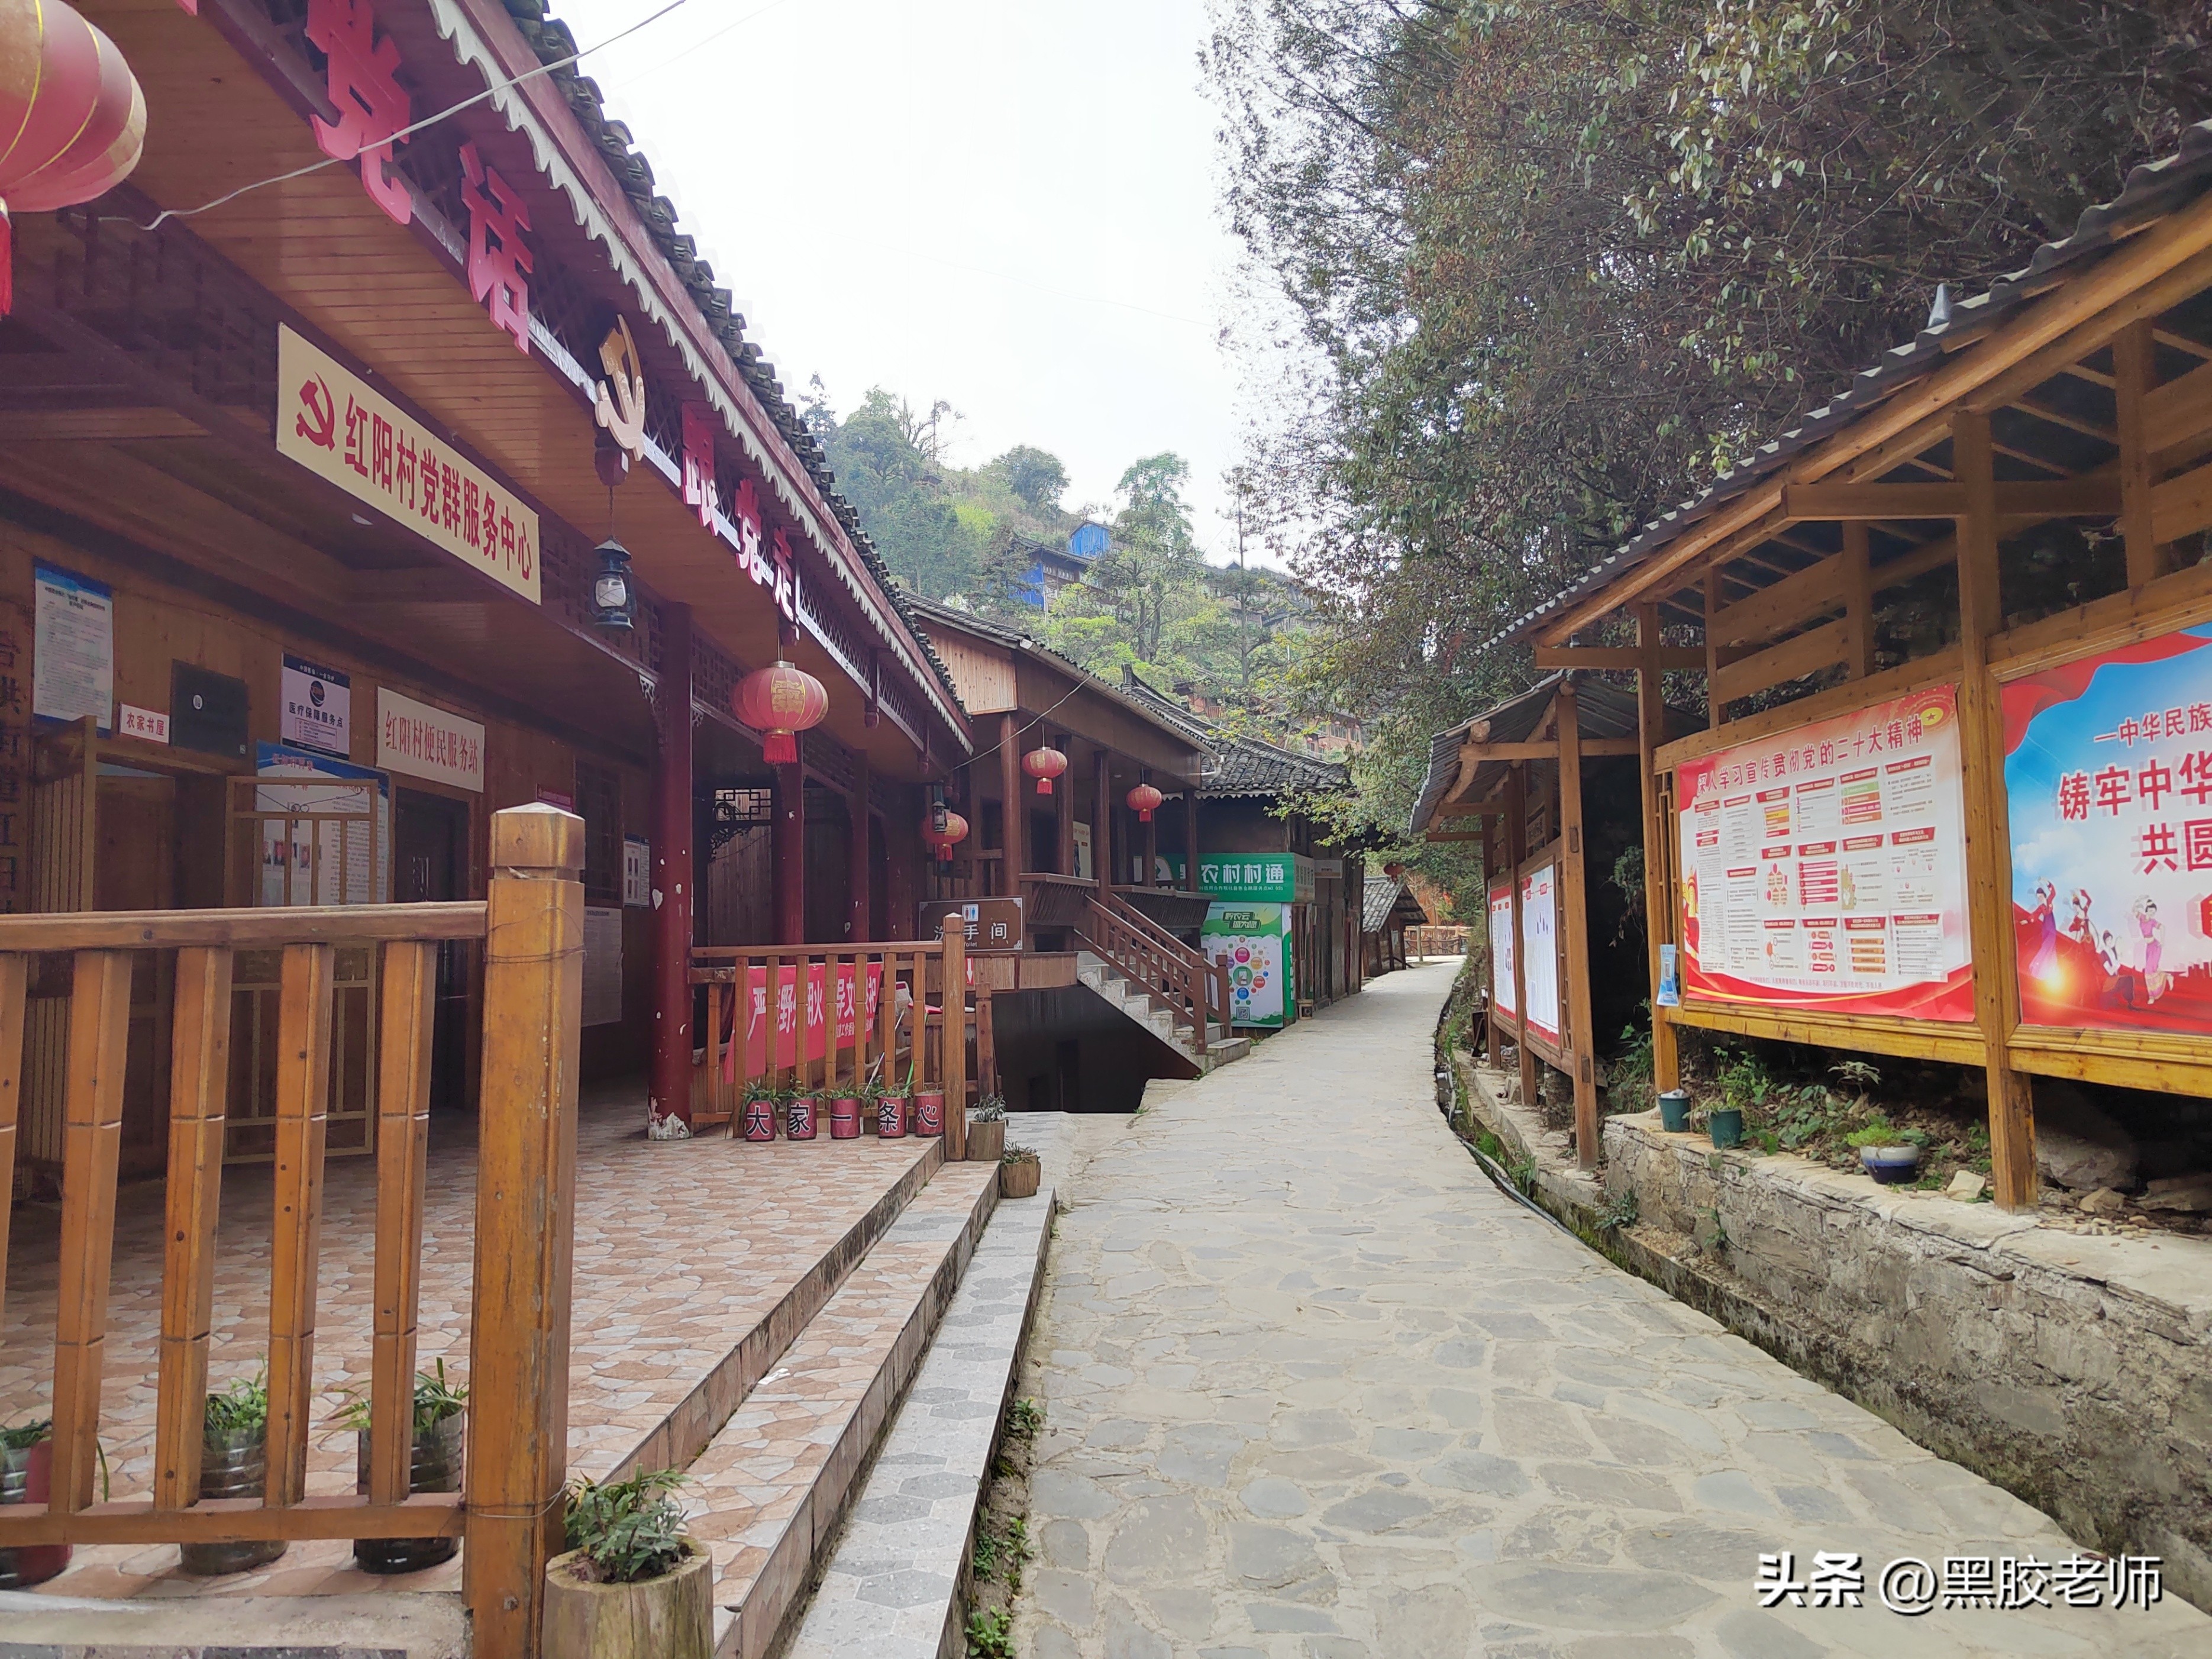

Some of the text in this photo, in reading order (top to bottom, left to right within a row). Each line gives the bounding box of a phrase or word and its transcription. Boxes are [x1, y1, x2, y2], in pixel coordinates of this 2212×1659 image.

[344, 392, 532, 581] 红阳村党群服务中心
[682, 401, 795, 622] 跟党走
[126, 712, 164, 736] 农家书屋
[289, 702, 343, 728] 医疗保障服务点
[386, 710, 478, 774] 红阳村便民服务站
[1697, 715, 1924, 796] 深入学习宣传贯彻党的二十大精神
[2059, 750, 2212, 821] 铸牢中华
[2142, 818, 2212, 875] 共圆
[747, 1101, 939, 1137] 大家一条心
